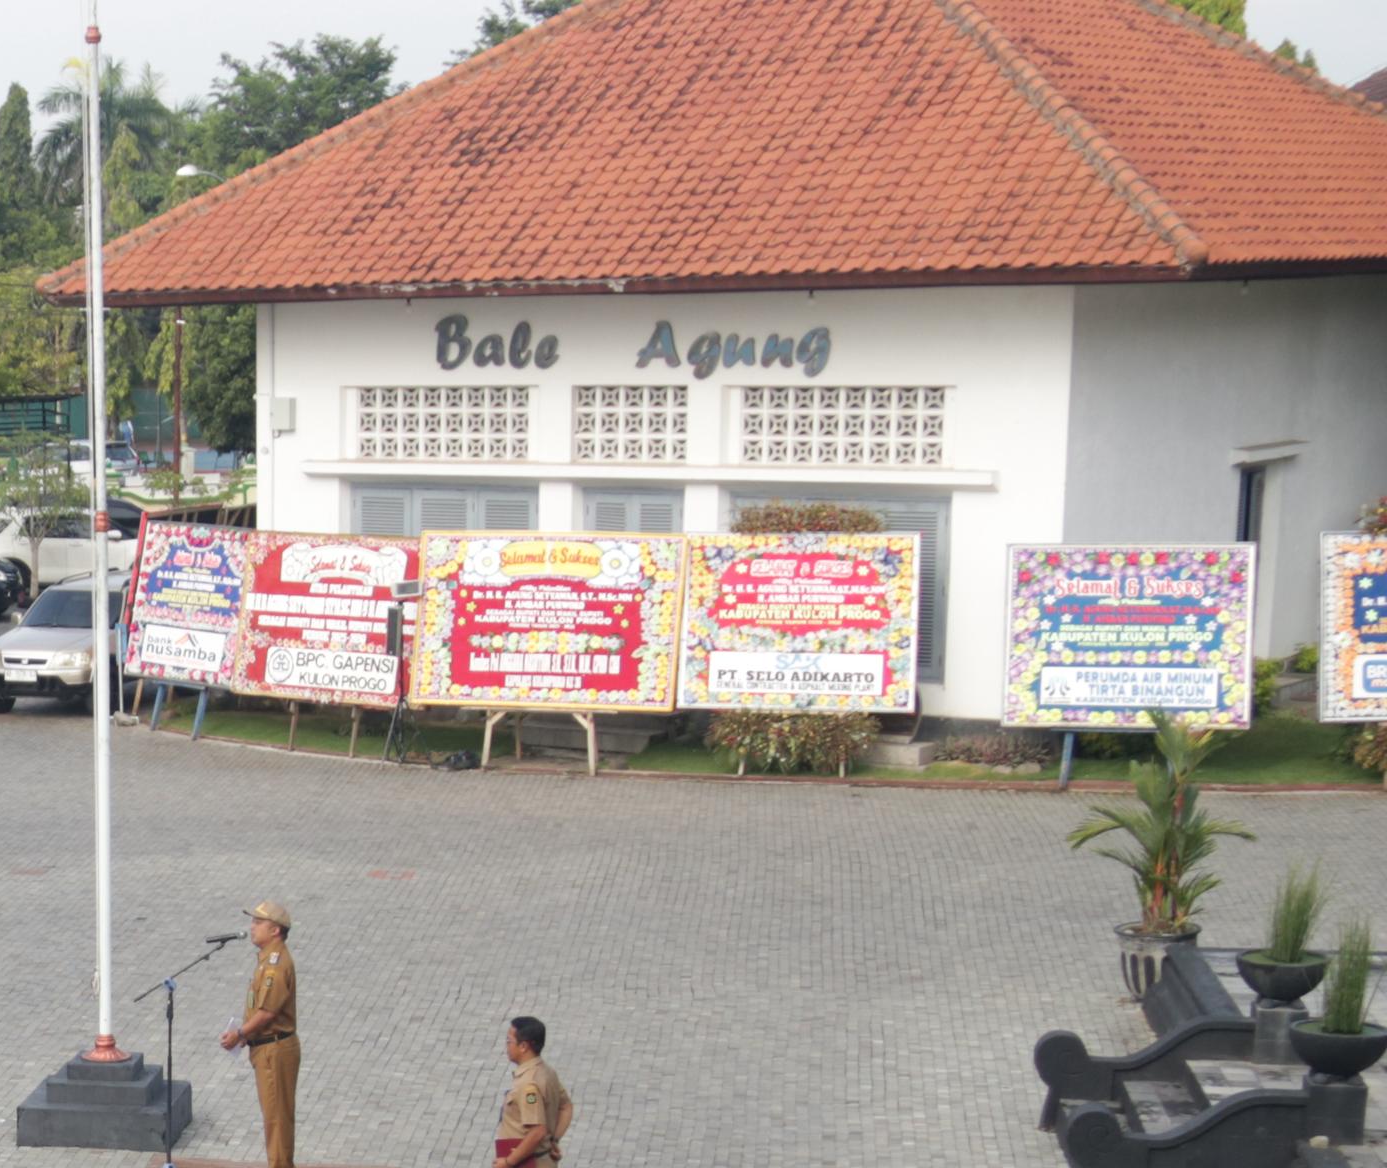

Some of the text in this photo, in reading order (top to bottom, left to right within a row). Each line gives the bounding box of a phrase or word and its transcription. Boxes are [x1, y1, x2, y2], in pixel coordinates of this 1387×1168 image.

[434, 313, 831, 380] Bale Agung
[499, 550, 546, 568] Selamat
[560, 547, 600, 566] Sukses
[1054, 576, 1205, 598] Selamat & Sukses
[719, 609, 881, 620] KABUPATEN KULON PROGO
[147, 634, 172, 645] bank
[1041, 631, 1213, 642] KABUPATEN KULON PROGO
[146, 643, 217, 662] nusamba
[332, 654, 395, 674] GAPENSI
[299, 671, 387, 692] KULON PROGO
[746, 670, 785, 682] SELO
[790, 671, 875, 683] ADIKARTO
[1075, 671, 1213, 684] PERUMDA AIR MINUM
[1088, 684, 1205, 697] TIRTA BINANGUN
